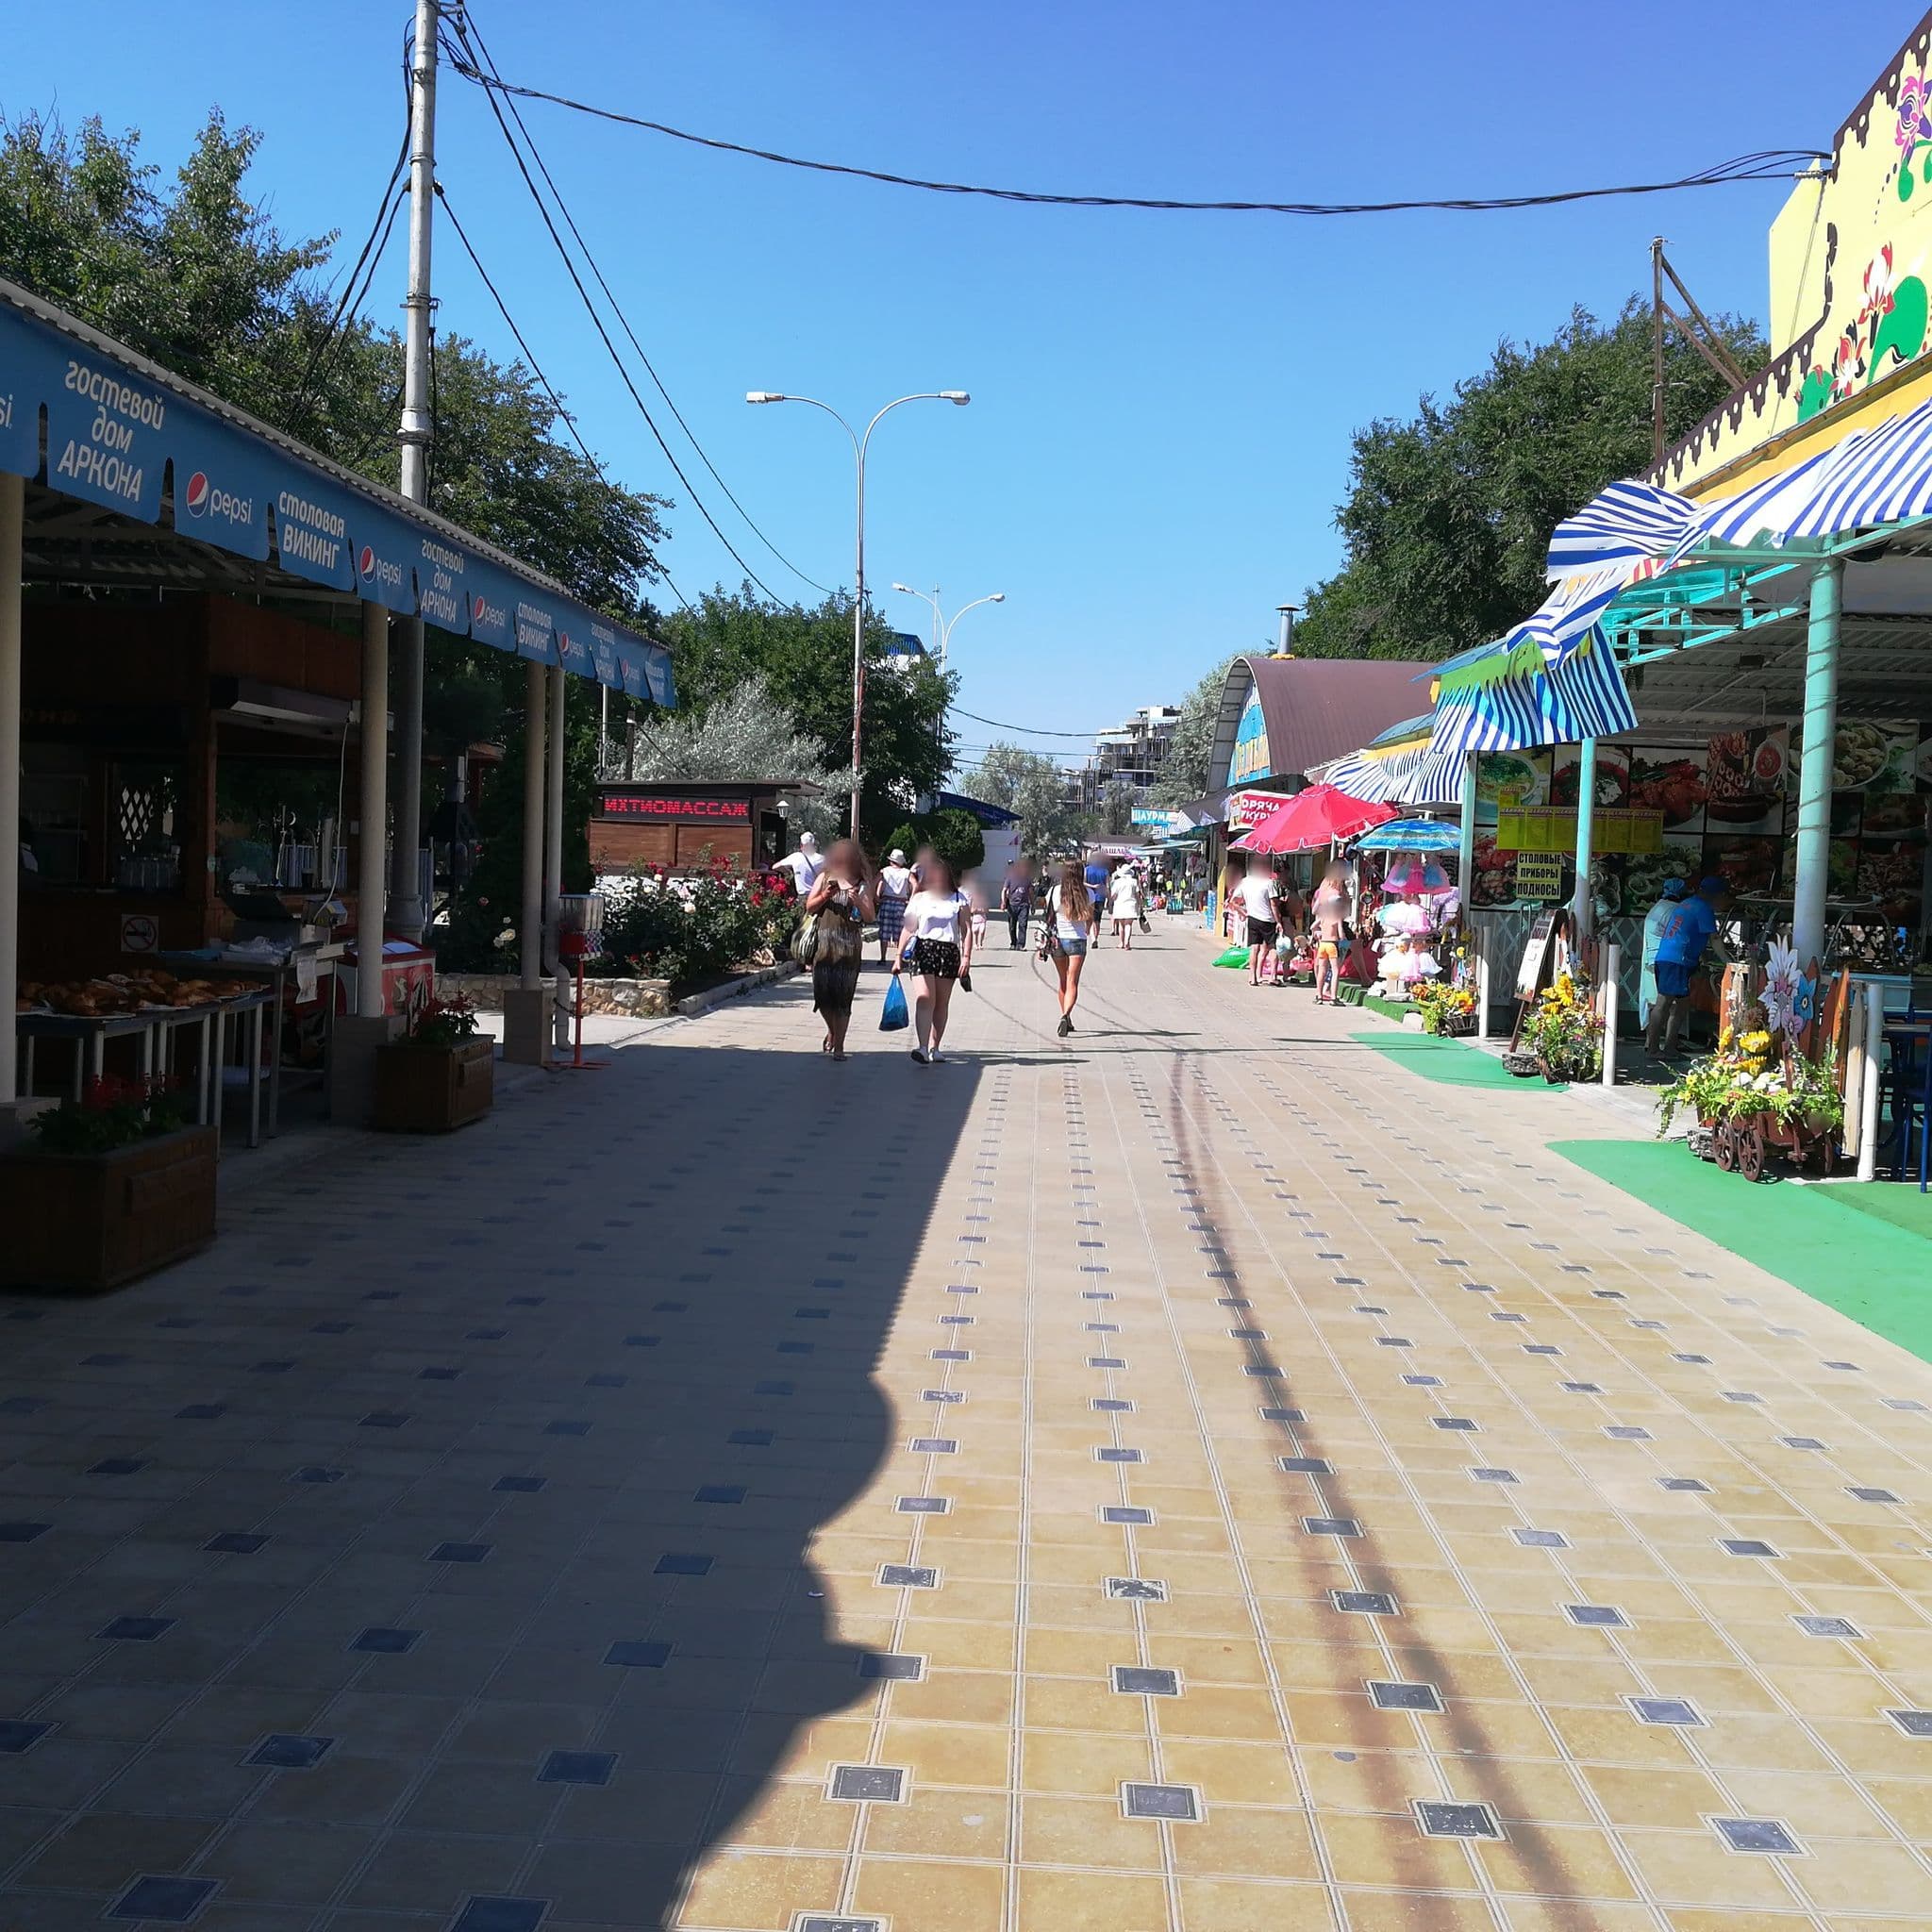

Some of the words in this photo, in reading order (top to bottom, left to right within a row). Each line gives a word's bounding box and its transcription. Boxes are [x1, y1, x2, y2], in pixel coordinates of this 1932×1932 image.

[65, 361, 165, 430] гостевой
[92, 406, 133, 453] дом
[58, 440, 142, 502] АРКОНА
[210, 489, 253, 525] pepsi
[278, 491, 345, 539] столовая
[282, 524, 341, 570] ВИКИНГ
[422, 539, 464, 575] гостевой
[376, 558, 402, 586] pepsi
[434, 564, 452, 592] дом
[421, 589, 457, 623] АРКОНА
[484, 607, 507, 628] pepsi
[518, 624, 550, 652] ВИКИНГ
[1241, 799, 1280, 812] ОРЯЧА
[1519, 853, 1561, 864] СТОЛОВЫЕ
[1520, 867, 1559, 879] ПРИБОРЫ
[1517, 883, 1559, 897] ПОДНОСЫ
